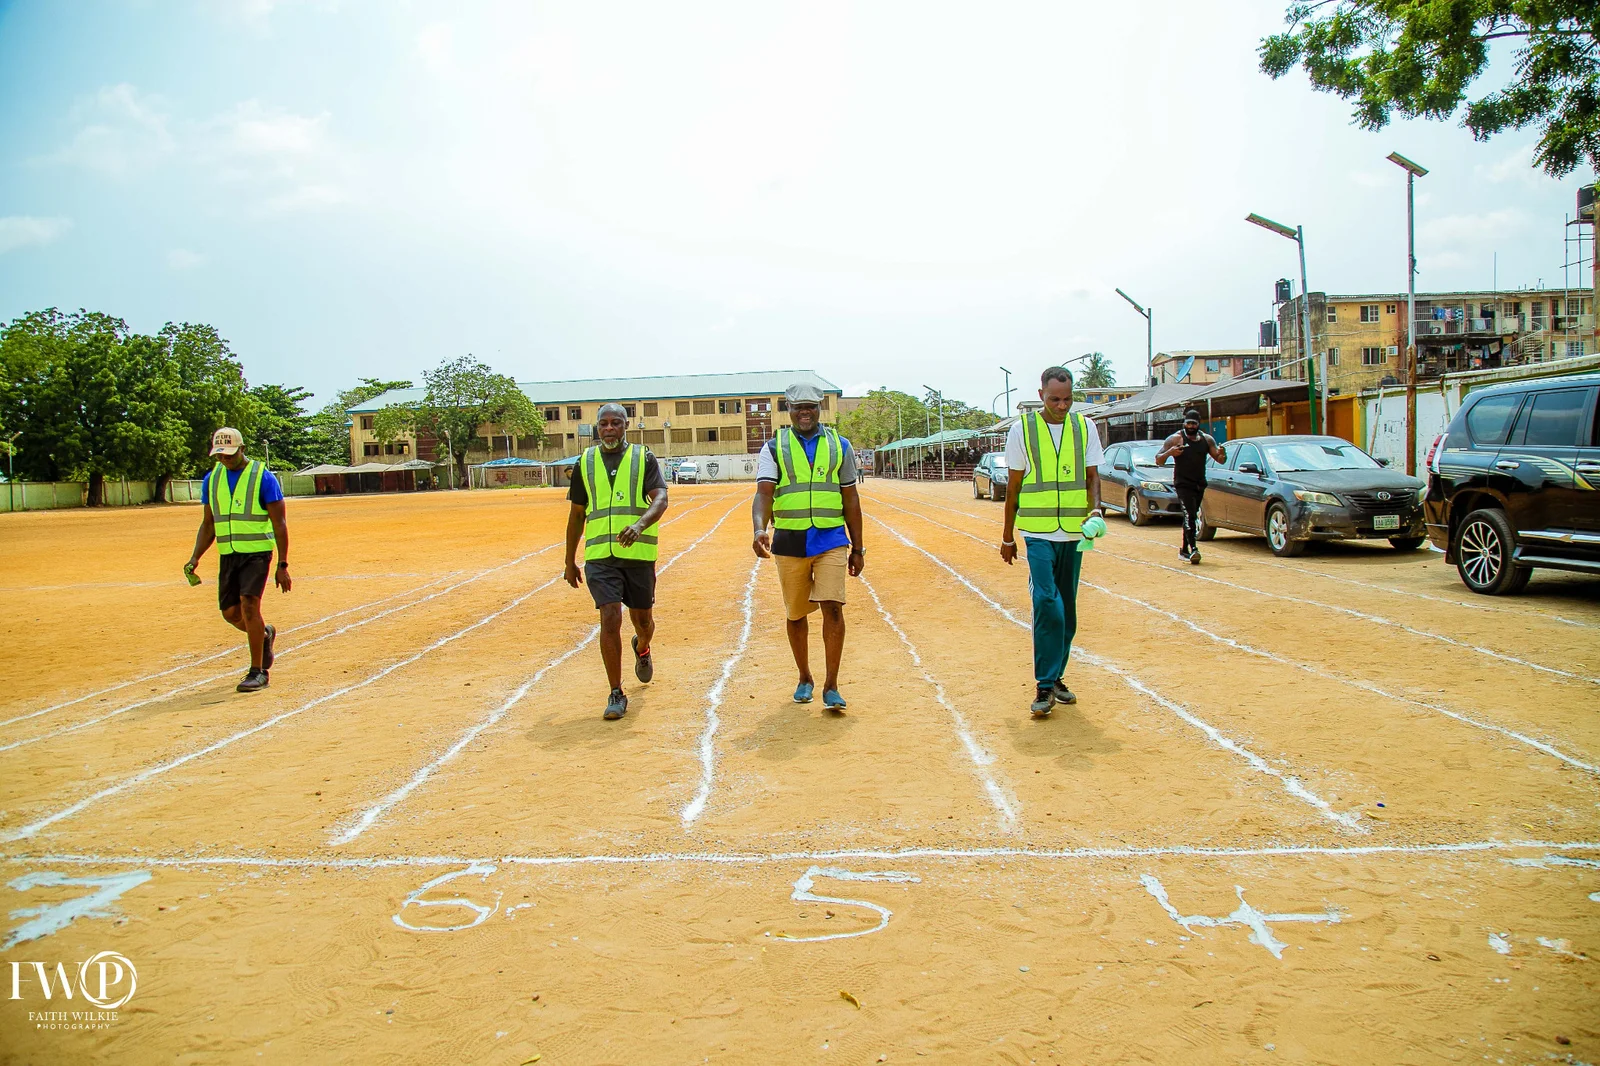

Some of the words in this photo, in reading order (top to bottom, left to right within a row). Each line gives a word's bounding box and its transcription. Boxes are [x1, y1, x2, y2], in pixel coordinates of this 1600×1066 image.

[0, 870, 152, 951] 7
[392, 862, 503, 932] 6
[771, 865, 921, 942] 5
[1138, 873, 1342, 960] 4
